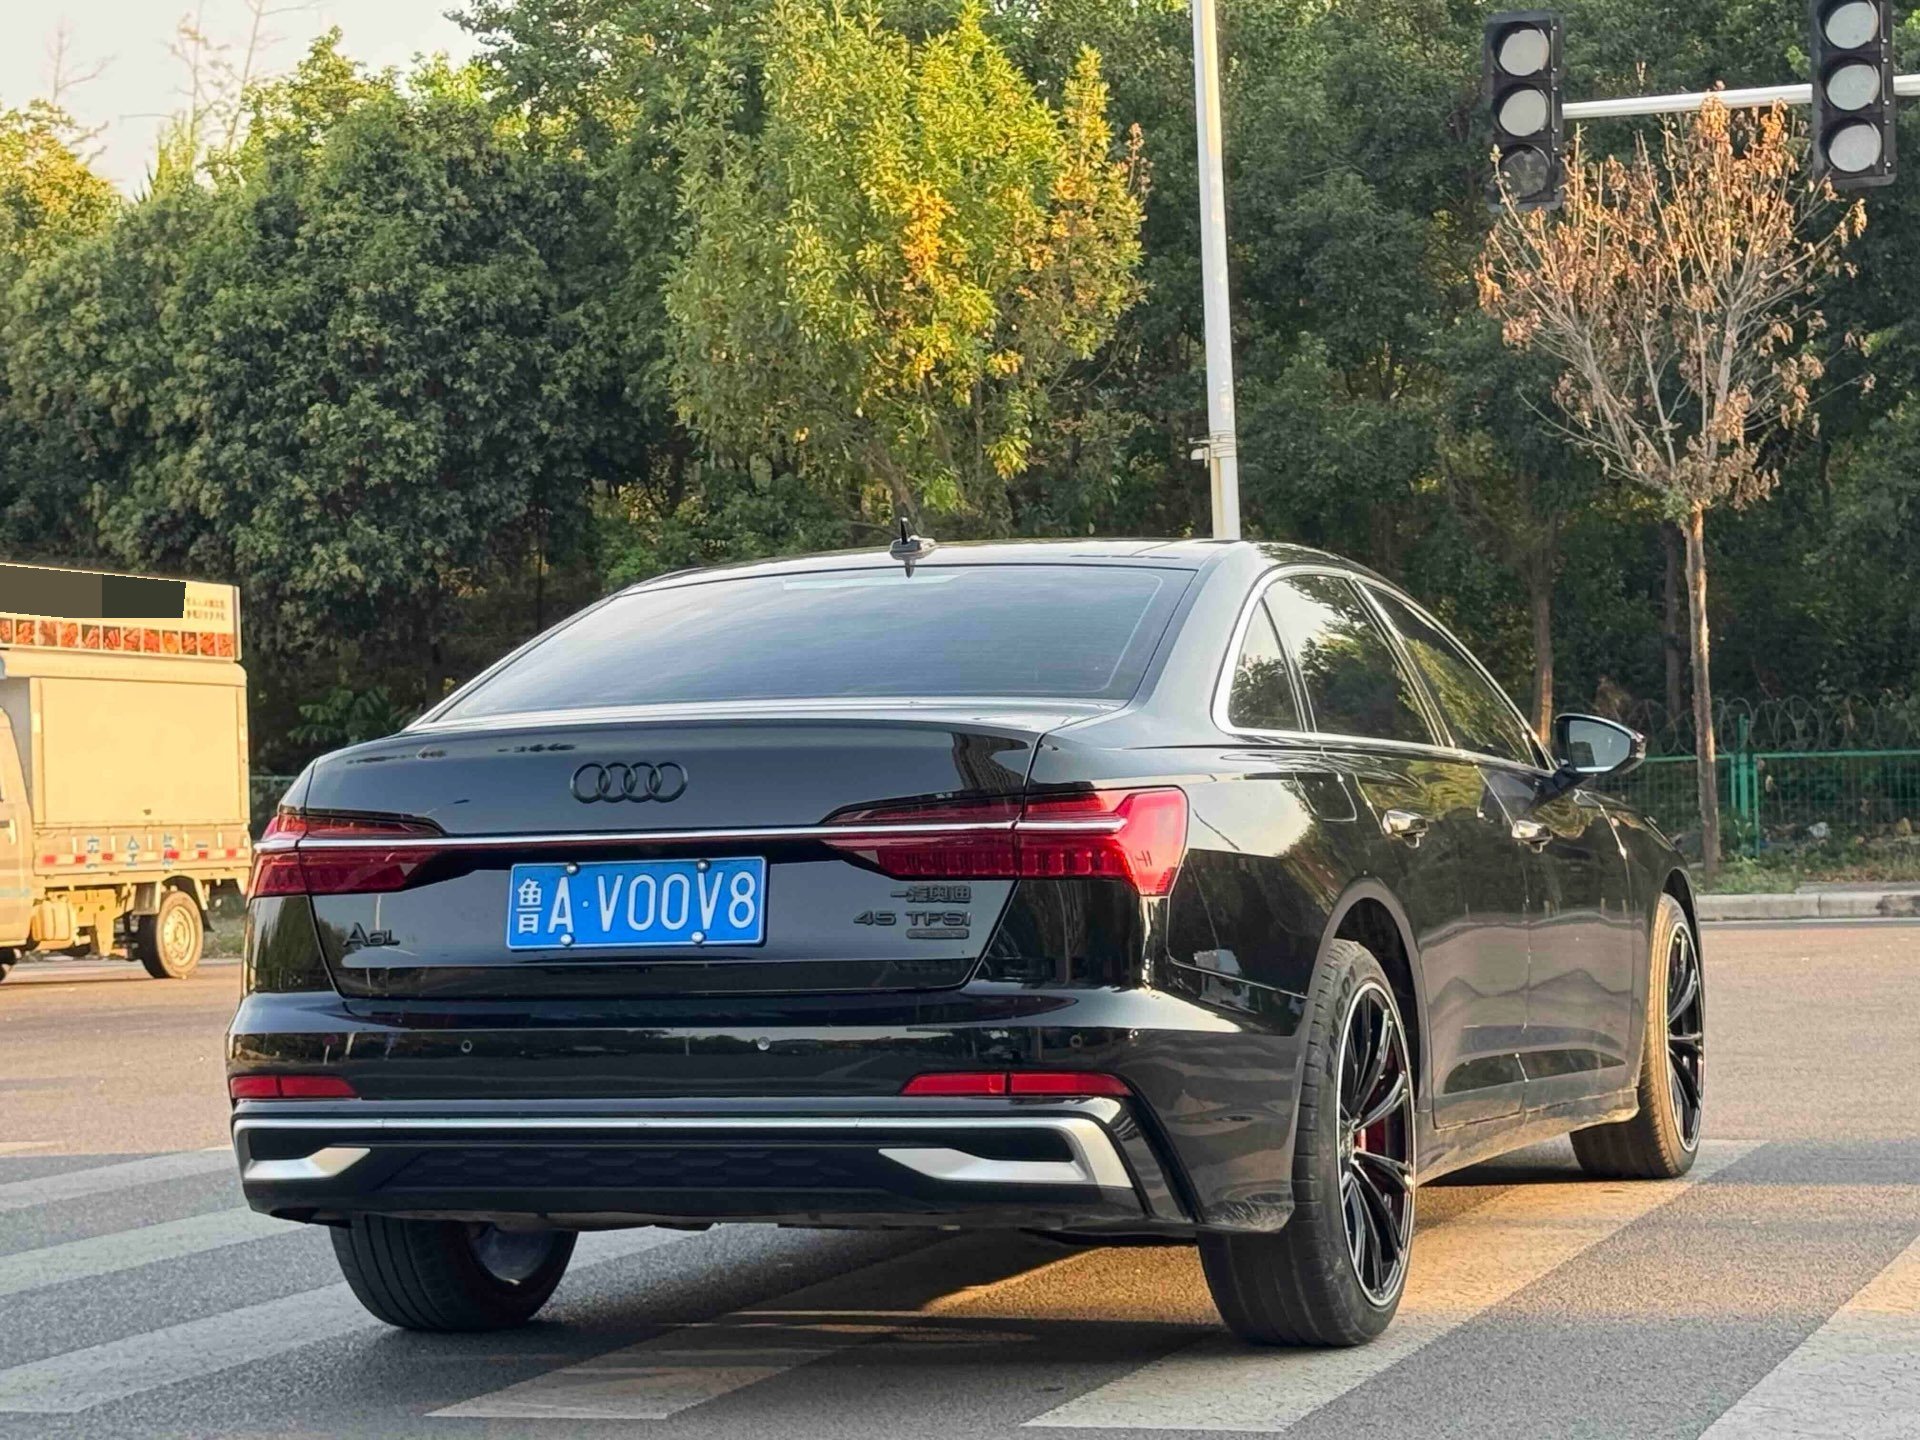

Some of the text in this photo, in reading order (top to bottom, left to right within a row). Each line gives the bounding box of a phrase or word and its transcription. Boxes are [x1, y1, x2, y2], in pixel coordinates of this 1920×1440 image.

[853, 911, 971, 926] 45 TFSI
[342, 922, 400, 947] A6L
